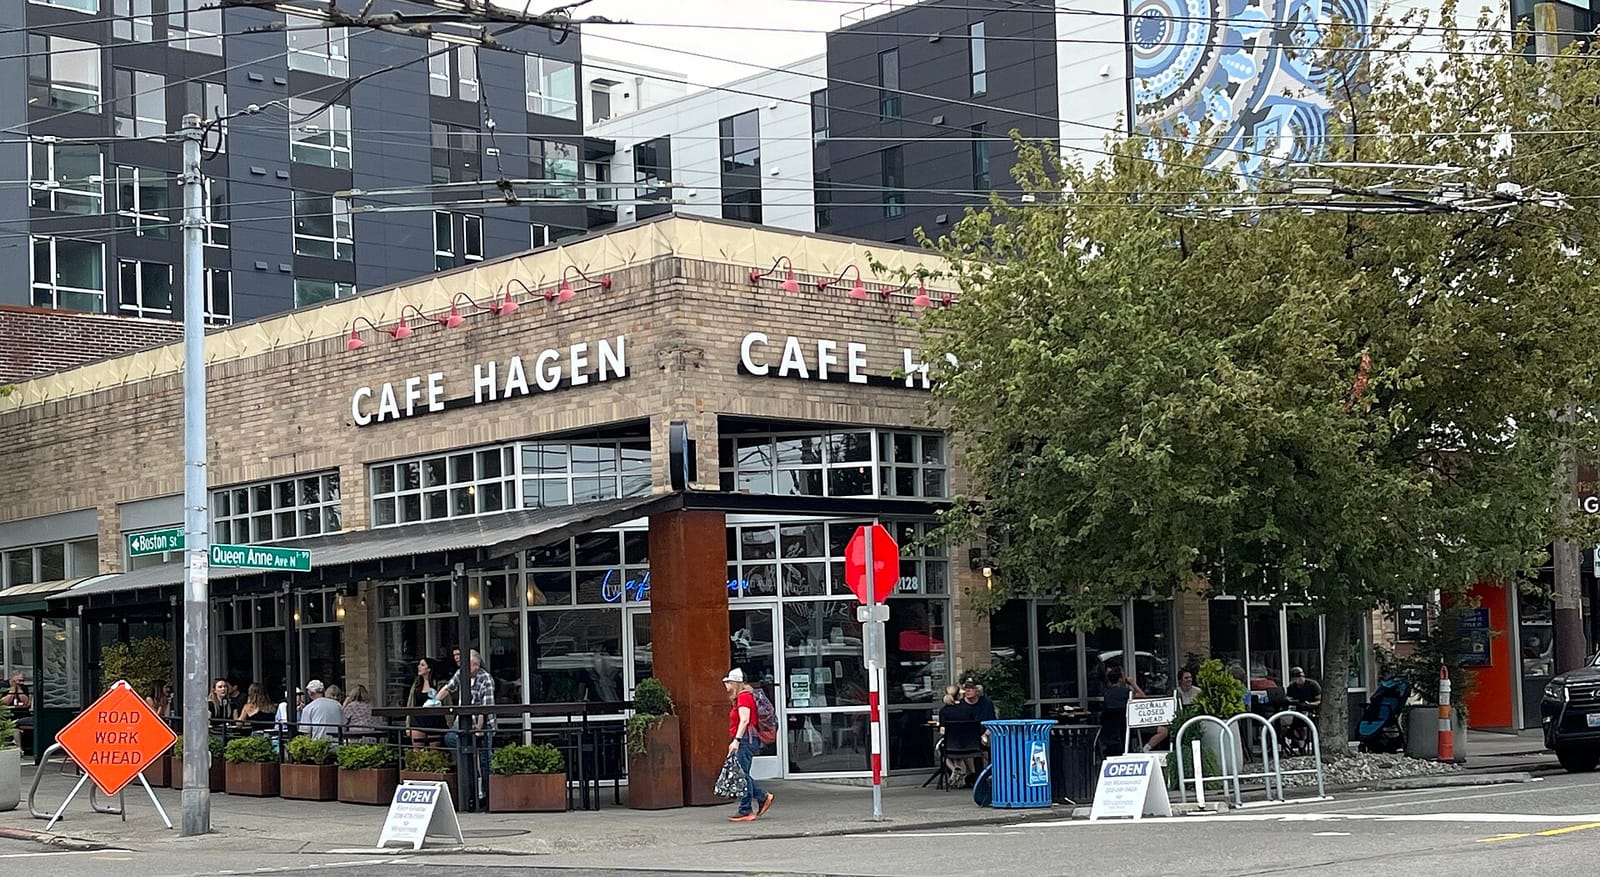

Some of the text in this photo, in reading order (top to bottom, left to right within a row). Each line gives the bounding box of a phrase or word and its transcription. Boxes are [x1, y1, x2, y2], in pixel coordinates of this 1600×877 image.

[740, 332, 868, 384] CAFE
[352, 335, 627, 426] CAFE HAGEN
[139, 534, 167, 551] Boston
[169, 535, 178, 547] St
[213, 546, 245, 564] Queen
[247, 548, 273, 566] Anne
[274, 555, 288, 566] Ave
[289, 555, 296, 567] N
[602, 568, 650, 602] Caf
[1135, 701, 1168, 710] SIDEWALK
[98, 711, 141, 724] ROAD
[1138, 708, 1165, 717] CLOSED
[1139, 715, 1163, 723] AHEAD
[95, 731, 139, 744] WORK
[89, 751, 142, 765] AHEAD
[1108, 763, 1144, 776] OPEN
[401, 790, 432, 802] OPEN
